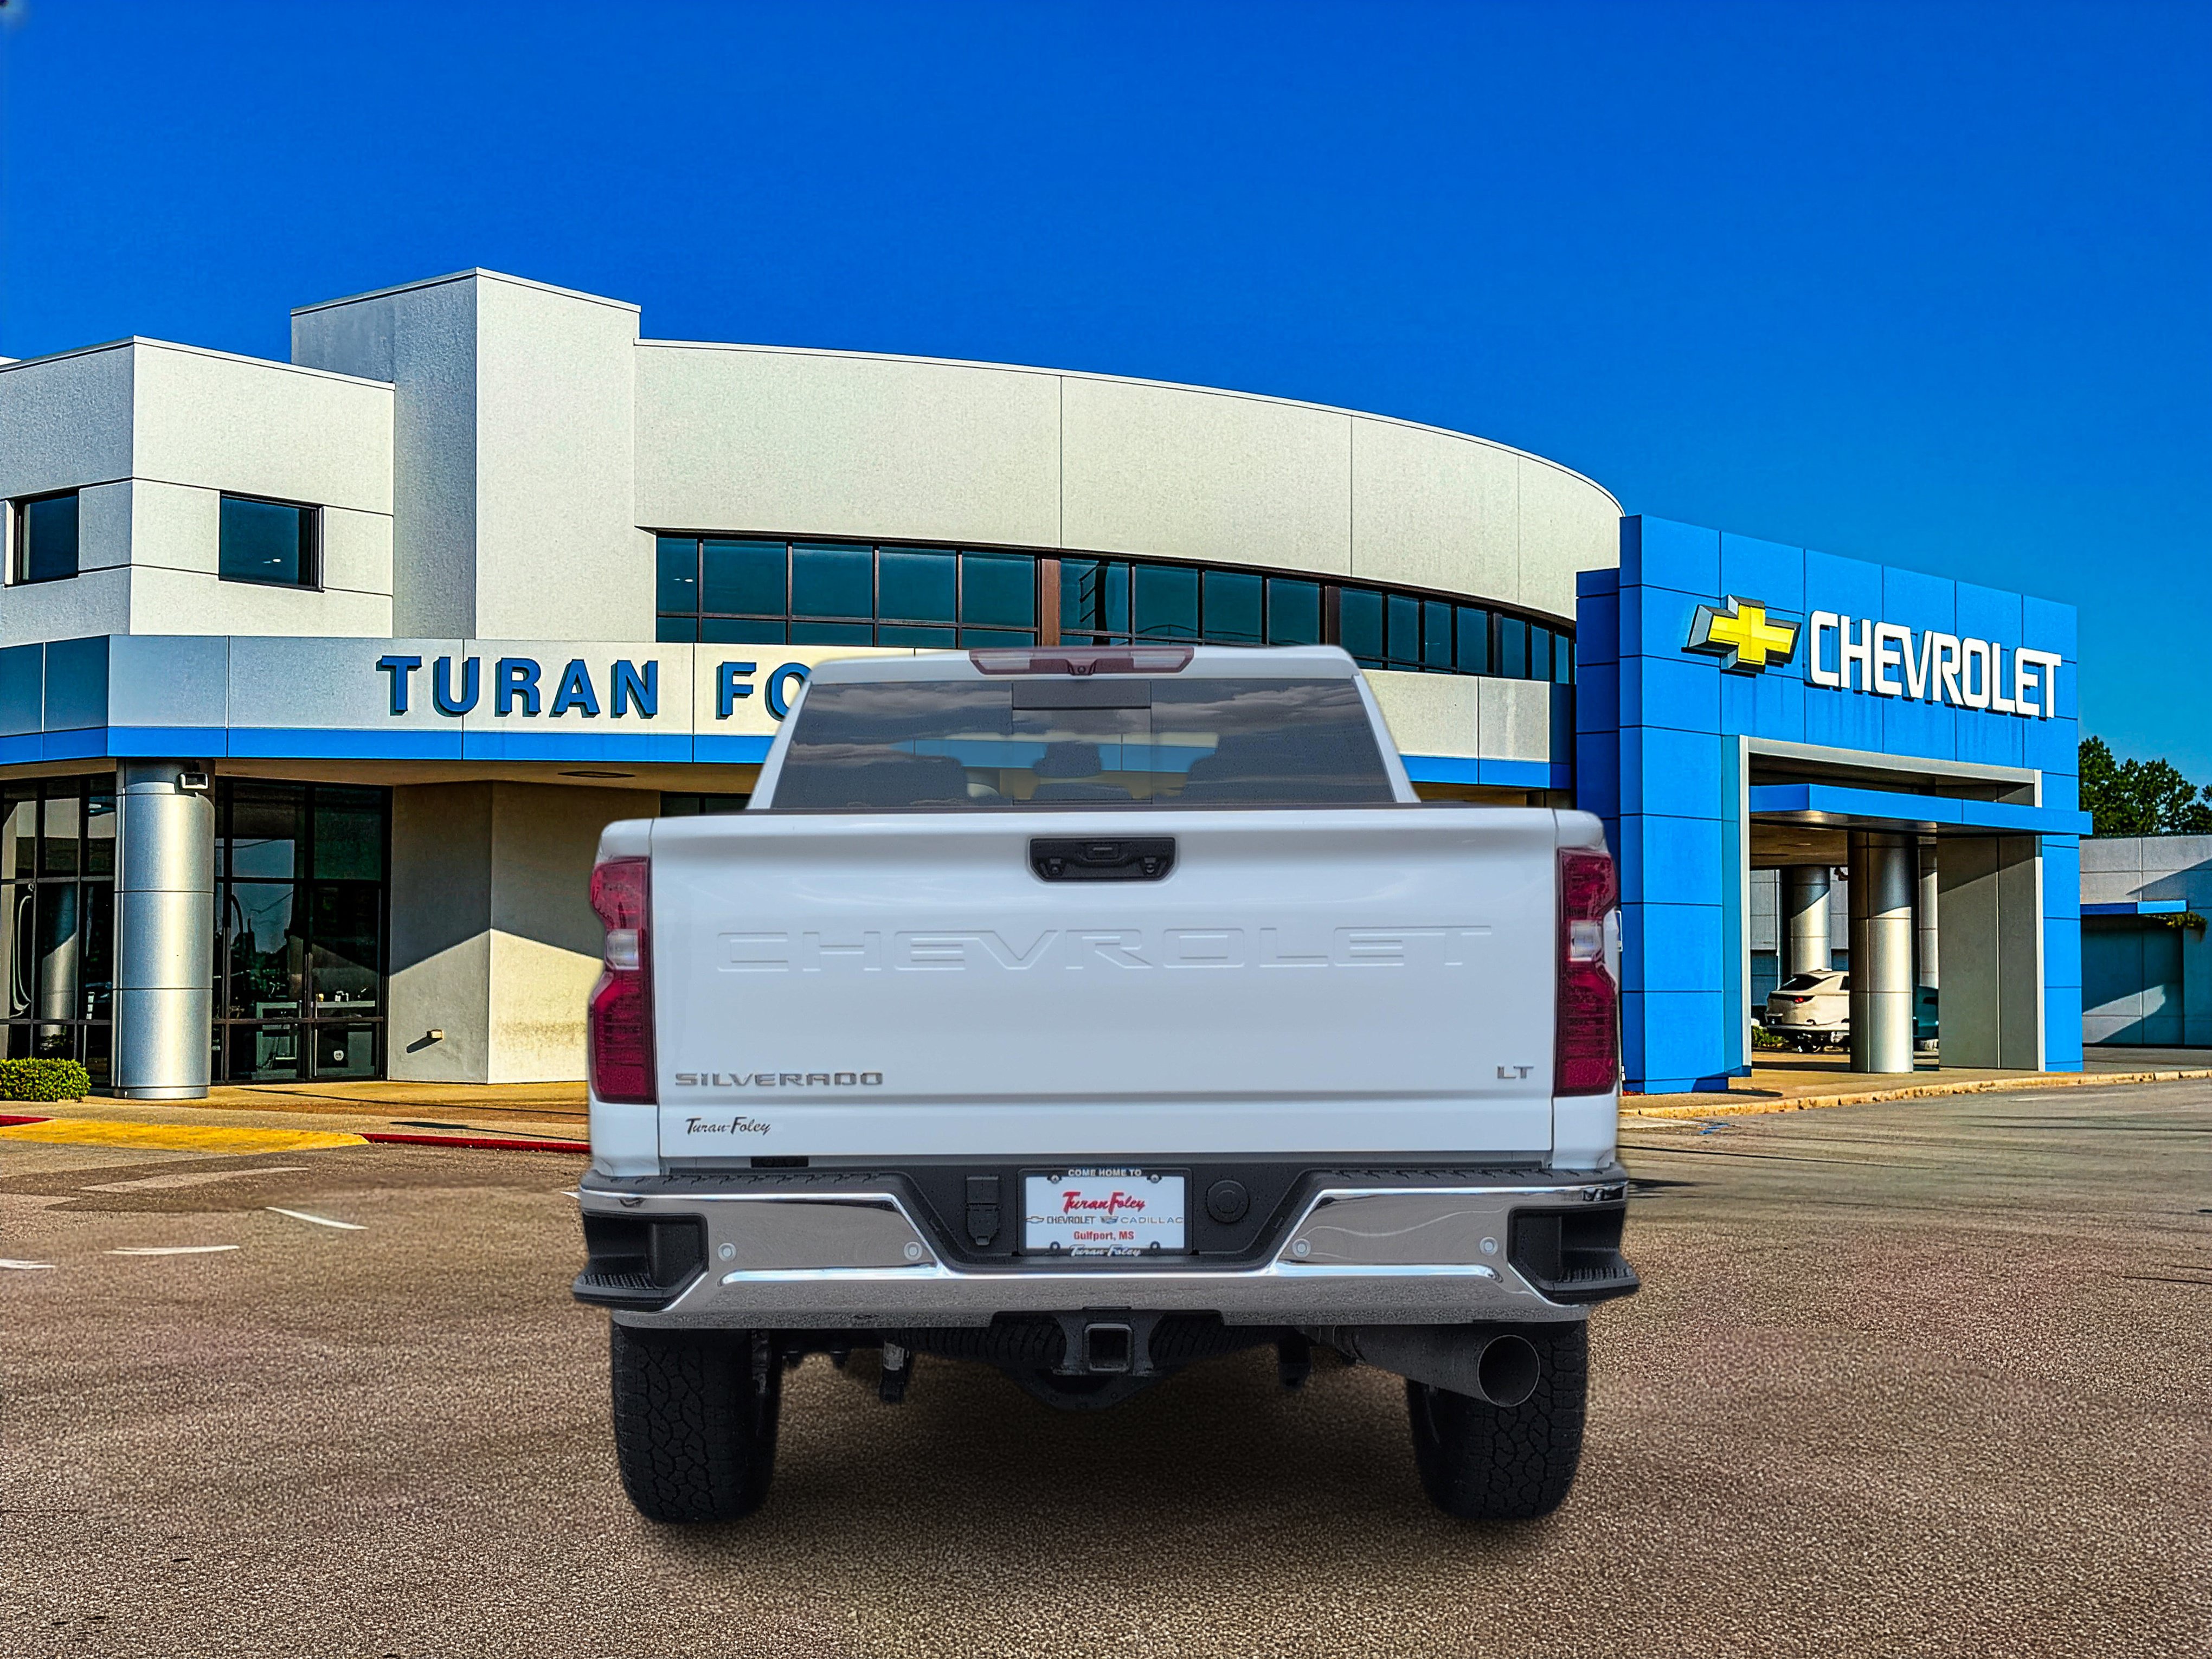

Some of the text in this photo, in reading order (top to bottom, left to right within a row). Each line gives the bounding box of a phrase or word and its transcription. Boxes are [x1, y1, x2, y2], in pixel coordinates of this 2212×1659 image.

[1810, 610, 2062, 720] CHEVROLET
[376, 654, 659, 719] TURAN
[717, 925, 1492, 972] CHEVROLET
[676, 1072, 883, 1086] SILVERADO
[1497, 1066, 1534, 1079] LT
[1047, 1216, 1095, 1224] CHEVROLET
[1074, 1231, 1134, 1242] Gulfport, MS
